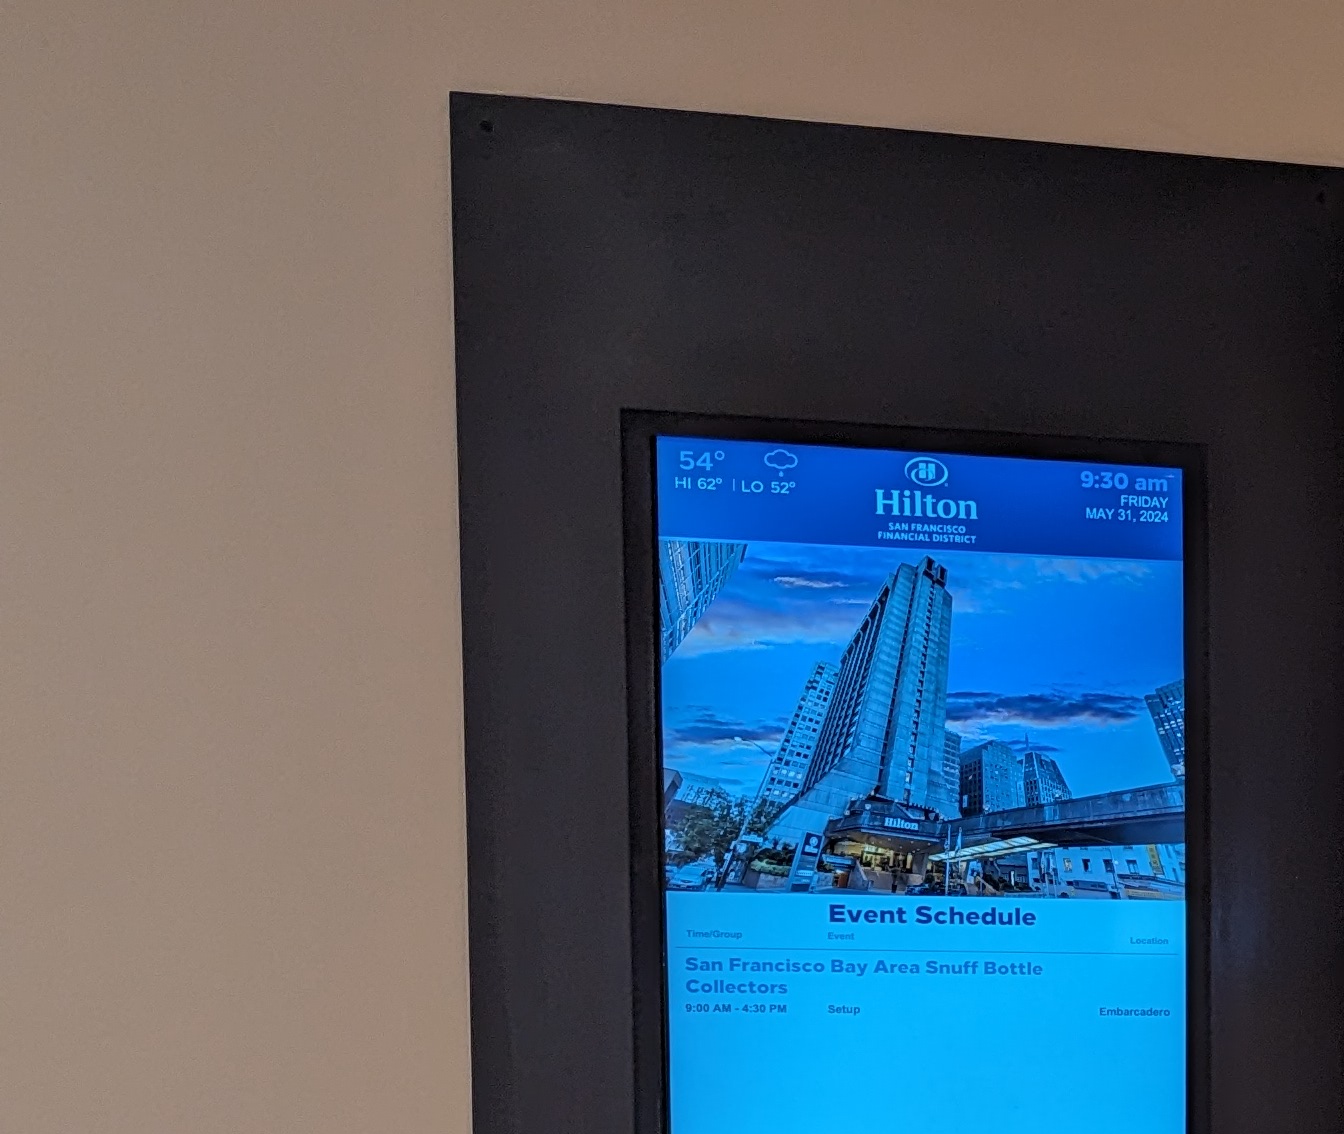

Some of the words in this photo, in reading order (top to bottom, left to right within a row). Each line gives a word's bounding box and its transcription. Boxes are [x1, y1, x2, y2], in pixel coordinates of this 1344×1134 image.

[679, 450, 725, 471] 54°
[674, 477, 691, 489] HI
[741, 480, 764, 493] LO
[1080, 470, 1129, 489] 9:30
[1135, 477, 1168, 491] am
[875, 488, 978, 520] Hilton
[1120, 495, 1168, 508] FRIDAY
[1086, 507, 1114, 520] MAY
[1118, 509, 1136, 522] 31,
[1139, 510, 1168, 522] 2024
[888, 522, 908, 531] SAN
[911, 523, 966, 533] FRANCISCO
[878, 531, 930, 541] FINANCIAL
[933, 534, 976, 543] DISTRICT
[884, 817, 919, 830] Hilton
[828, 904, 907, 924] Event
[915, 905, 1037, 926] Schedule
[686, 930, 742, 939] Time/Group
[827, 932, 855, 940] Event
[1130, 937, 1169, 945] Location
[685, 957, 723, 972] San
[729, 958, 825, 973] Francisco
[831, 959, 868, 977] Bay
[873, 959, 920, 974] Area
[925, 960, 978, 975] Snuff
[983, 961, 1043, 976] Bottle
[685, 979, 788, 994] Collectors
[685, 1004, 710, 1012] 9:00
[712, 1004, 732, 1012] AM
[742, 1004, 766, 1013] 4:30
[769, 1004, 787, 1013] PM
[828, 1005, 861, 1015] Setup
[1099, 1008, 1171, 1017] Embarcadero
